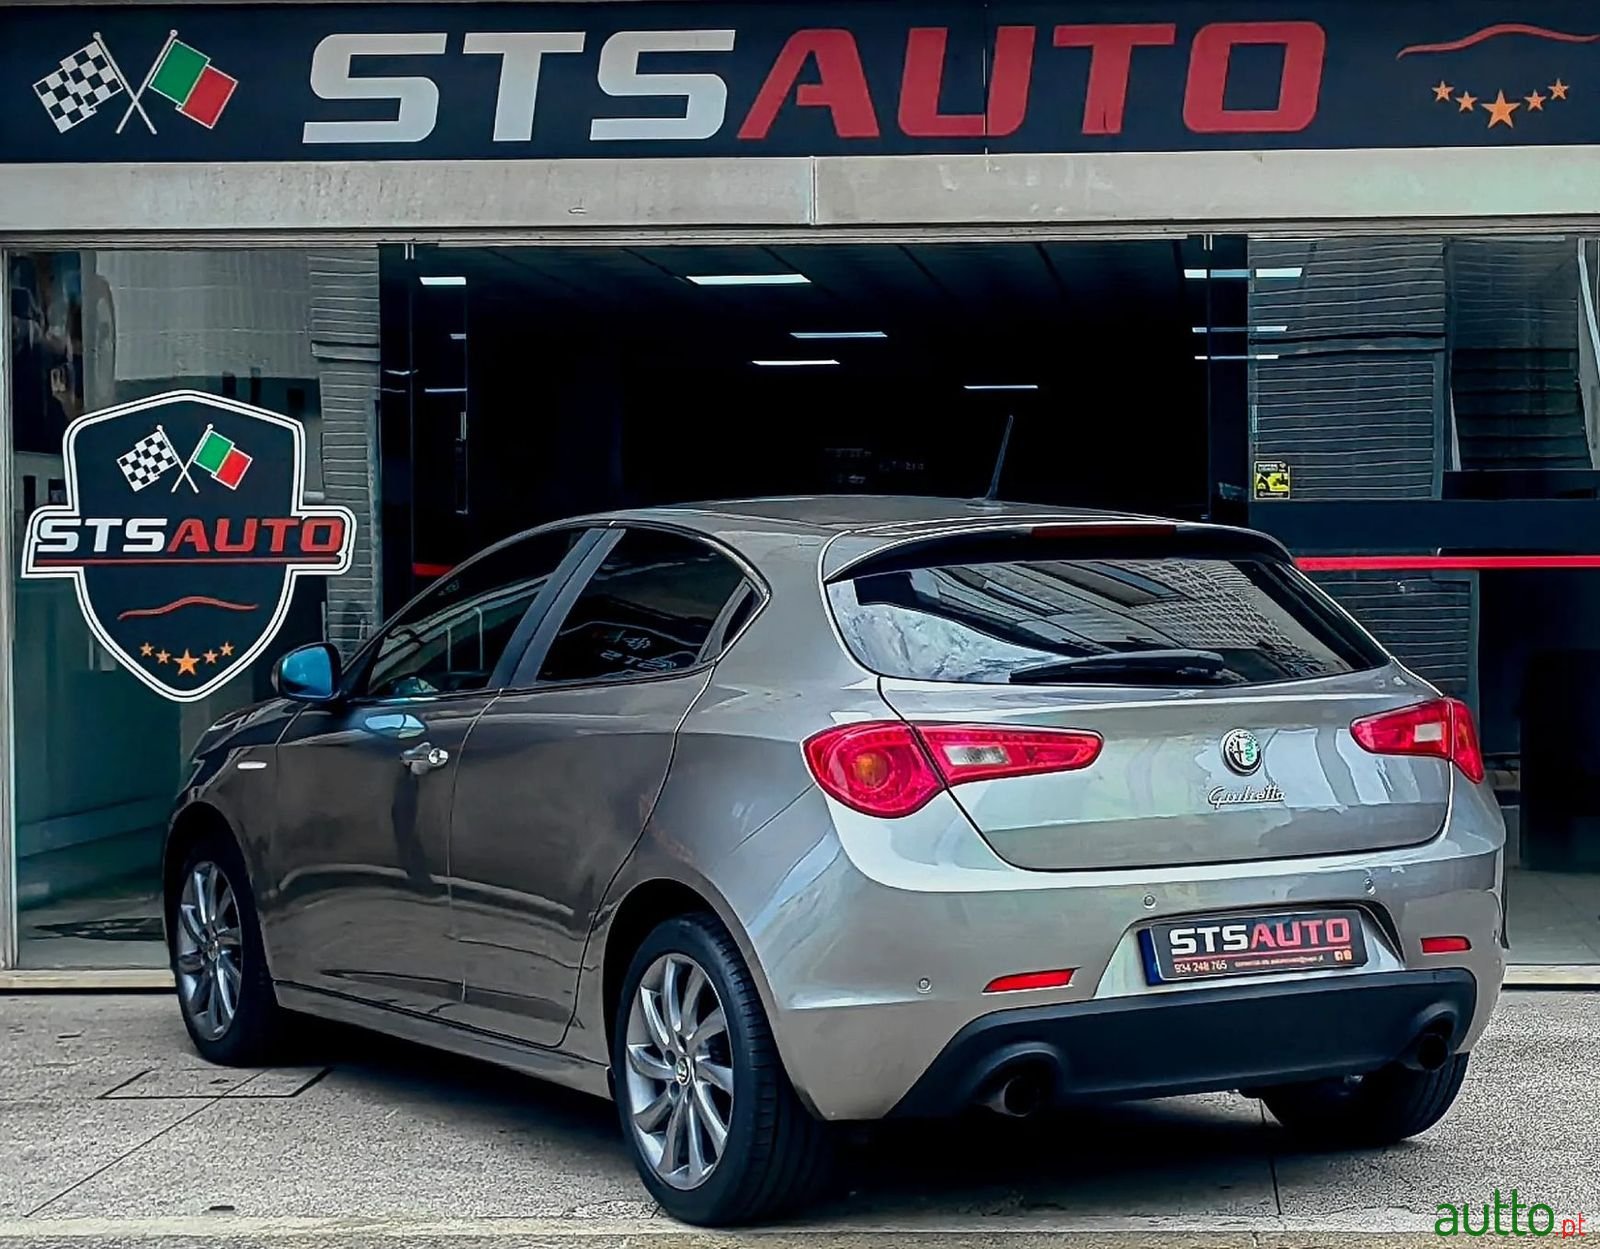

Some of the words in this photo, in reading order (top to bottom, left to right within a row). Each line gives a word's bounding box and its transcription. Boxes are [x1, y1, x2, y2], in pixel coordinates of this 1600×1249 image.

[302, 21, 1326, 143] STSAUTO
[37, 517, 344, 553] STSAUTO
[1169, 917, 1351, 956] STSAUTO
